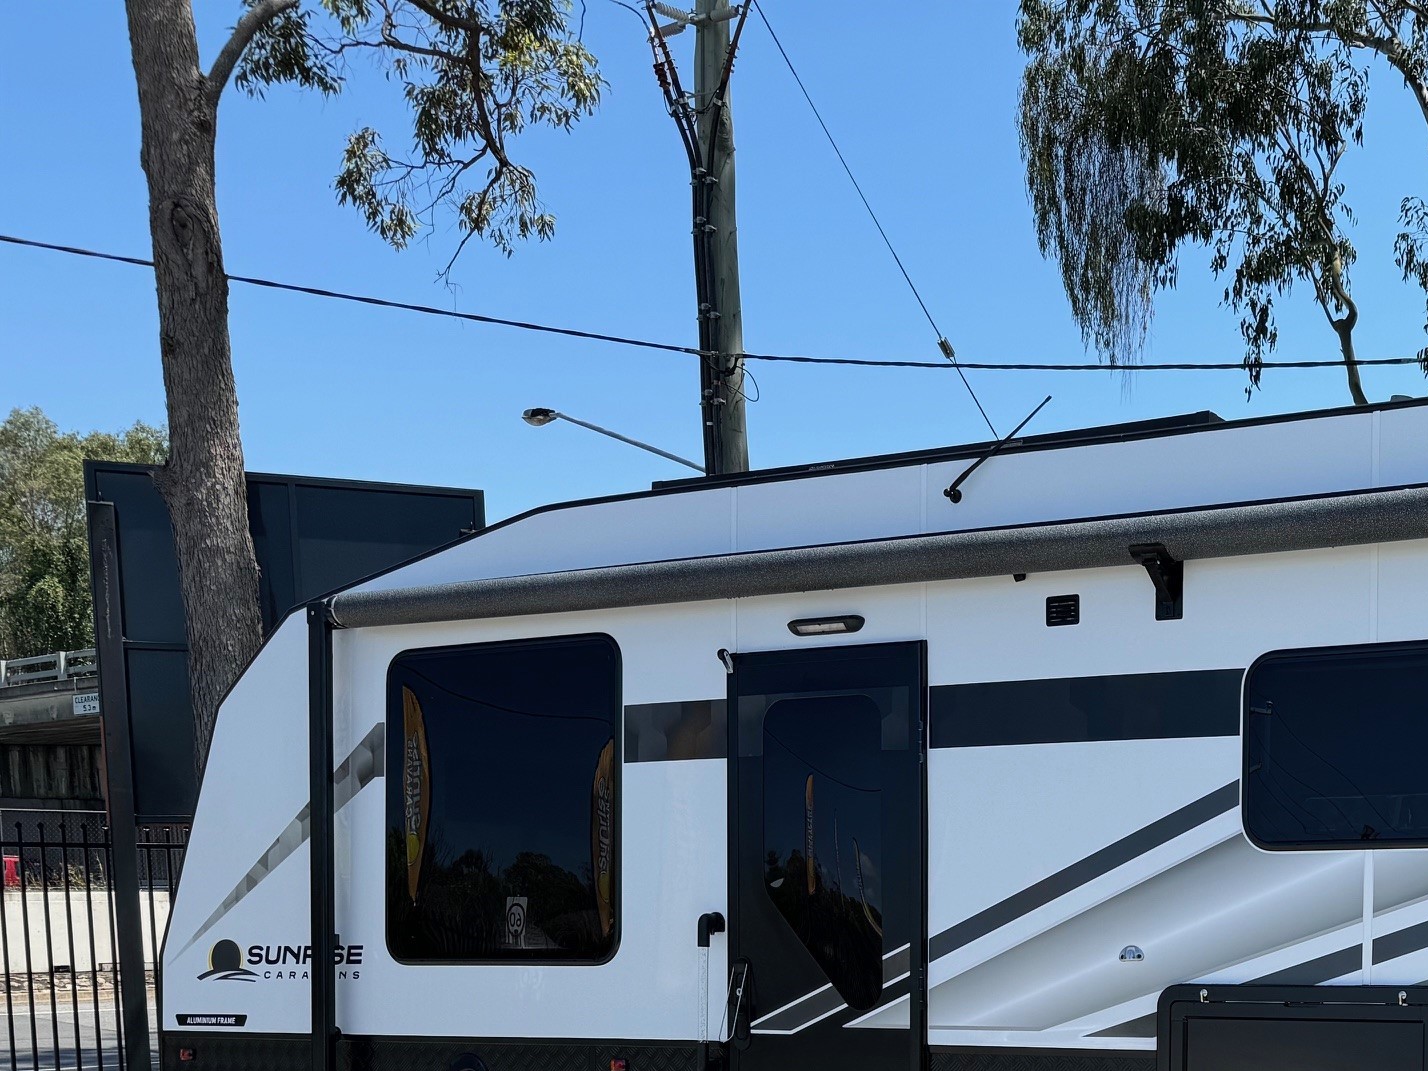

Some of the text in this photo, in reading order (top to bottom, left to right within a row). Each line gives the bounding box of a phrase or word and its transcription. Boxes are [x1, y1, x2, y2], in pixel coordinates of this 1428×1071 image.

[263, 970, 360, 980] CARANS
[186, 1016, 236, 1025] ALUMINIUM FRAME
